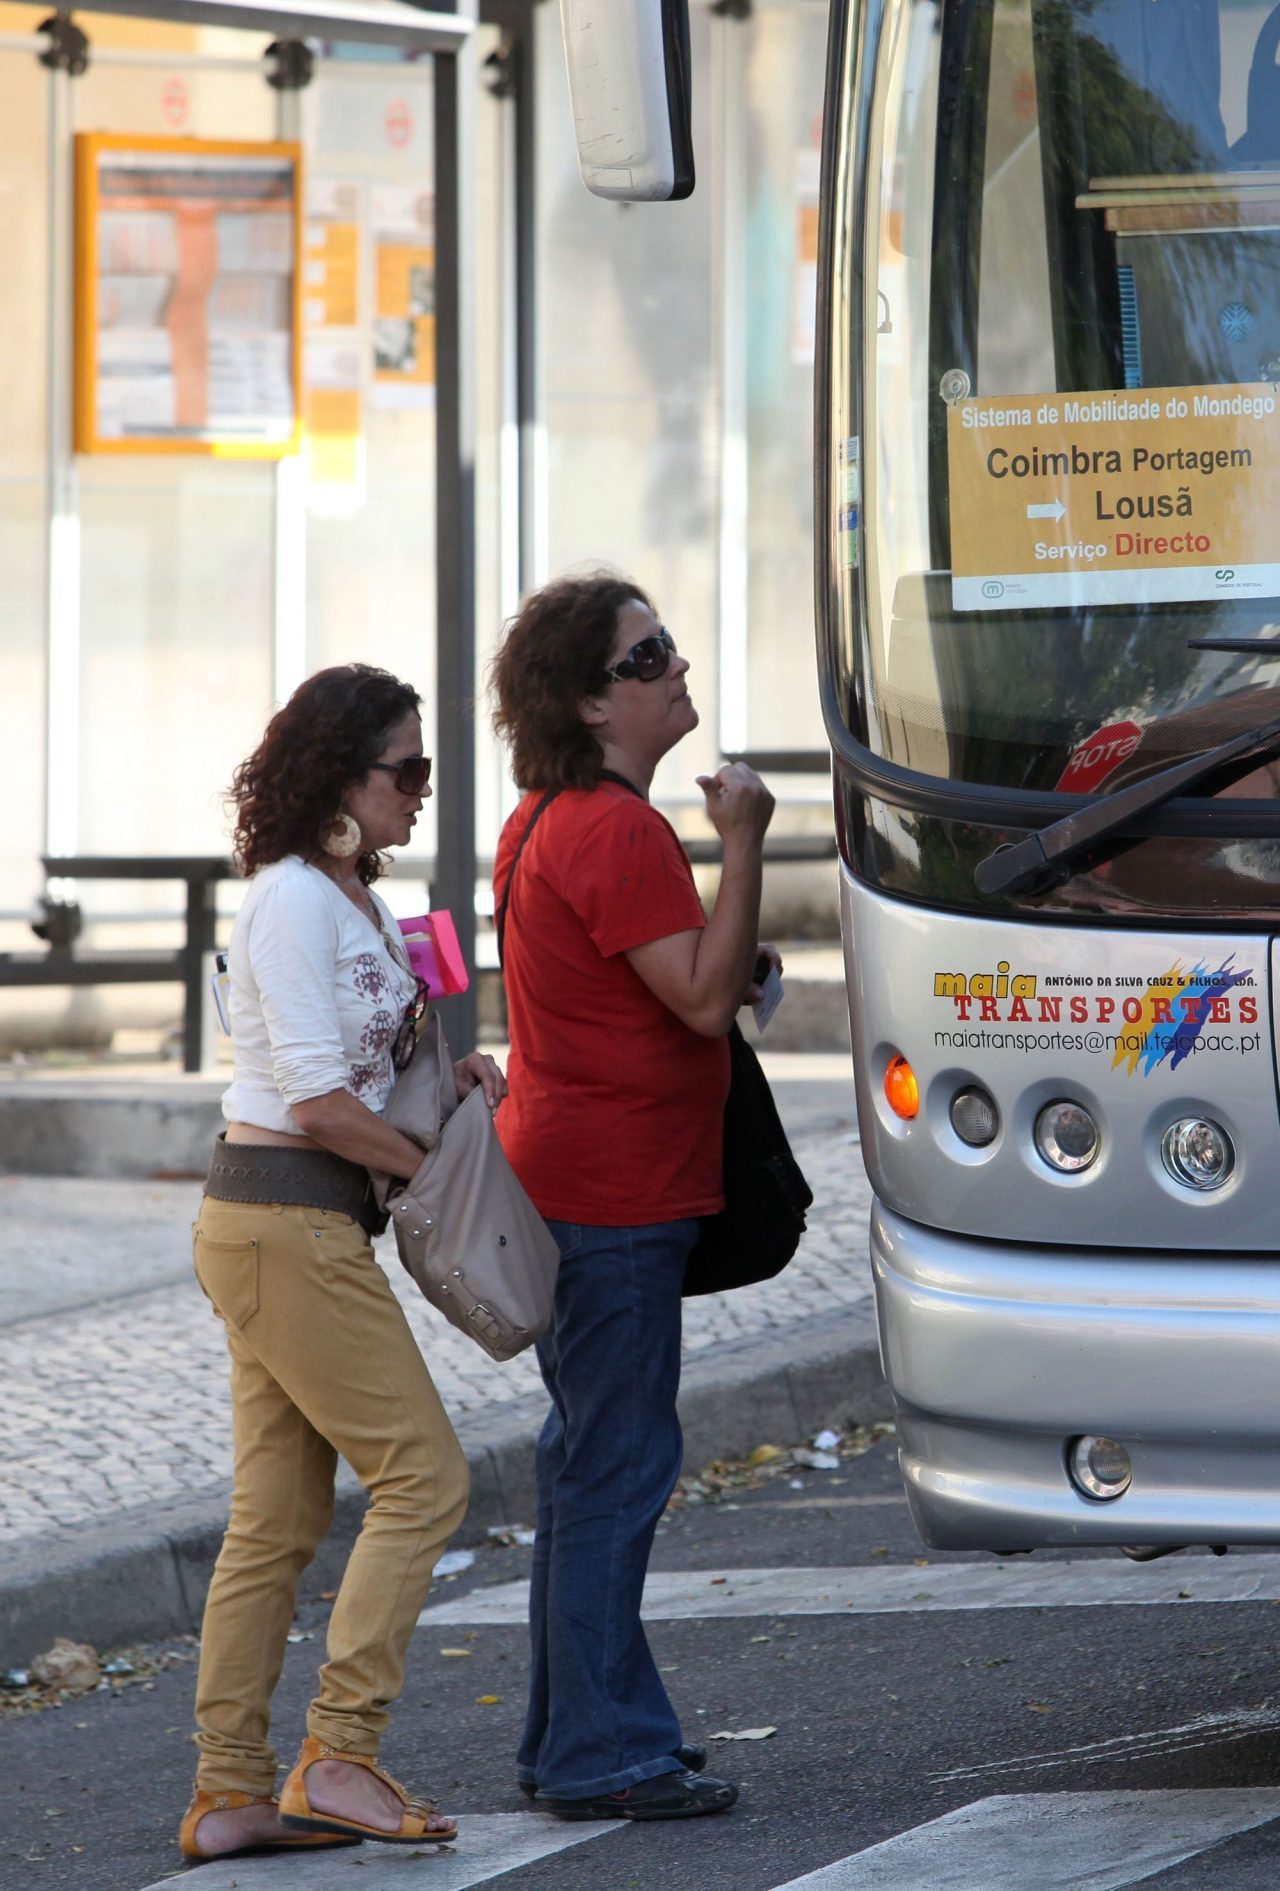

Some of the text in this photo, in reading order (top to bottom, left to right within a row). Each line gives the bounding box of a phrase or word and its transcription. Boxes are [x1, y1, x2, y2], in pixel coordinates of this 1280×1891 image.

[961, 393, 1275, 429] Sistema de Mobilidade do Mondego
[987, 443, 1252, 479] Coimbra Portagem
[1096, 487, 1193, 521] Lousã
[1034, 531, 1211, 563] Serviço Directo
[933, 960, 1037, 999] maia
[1045, 974, 1093, 987] ANTÓNIO
[1097, 976, 1112, 987] DA
[1115, 976, 1143, 987] SILVA
[1146, 976, 1173, 987] CRUZ
[1176, 976, 1186, 987] &
[1234, 976, 1258, 987] LDA.
[953, 994, 1259, 1024] TRANSPORTES
[934, 1028, 1261, 1055] maiatransportes@mail.telepac.pt
